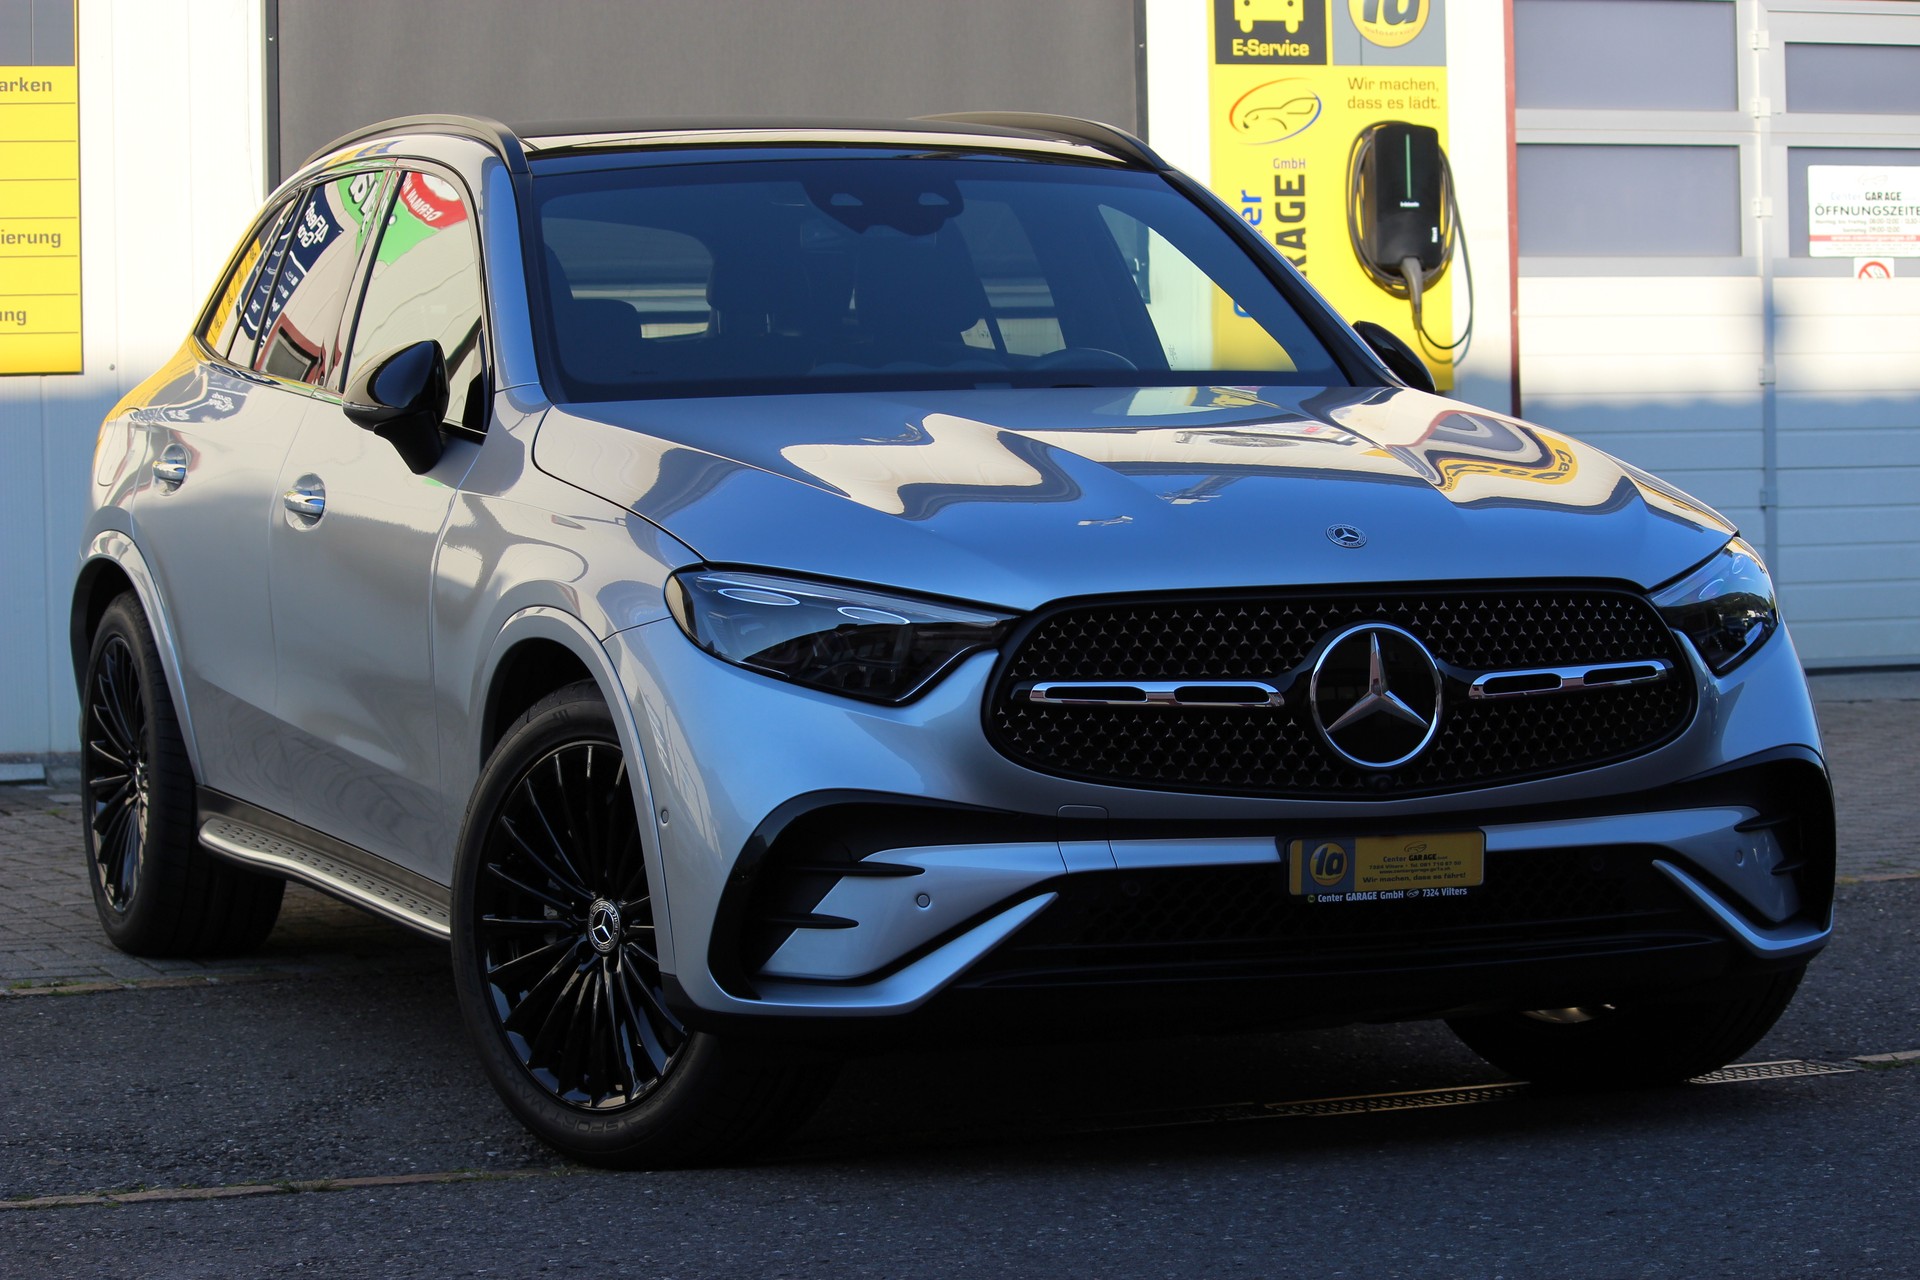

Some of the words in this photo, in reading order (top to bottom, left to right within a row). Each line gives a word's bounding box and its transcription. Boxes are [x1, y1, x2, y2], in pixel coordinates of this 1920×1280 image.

[1232, 38, 1309, 57] E-Service
[1348, 77, 1377, 90] Wir
[1379, 78, 1439, 92] machen,
[1347, 96, 1382, 109] dass
[1387, 99, 1406, 109] es
[1409, 96, 1441, 110] lädt.
[1273, 158, 1306, 169] GmbH
[1865, 191, 1902, 201] GARAGE
[1815, 203, 1920, 216] ÖFFNUNGSZEITE
[1316, 847, 1344, 876] 1a
[1383, 855, 1407, 863] Center
[1318, 894, 1343, 903] Center
[1346, 892, 1377, 902] GARAGE
[1380, 890, 1404, 900] GmbH
[1422, 889, 1440, 897] 7324
[1441, 887, 1467, 897] Vilters
